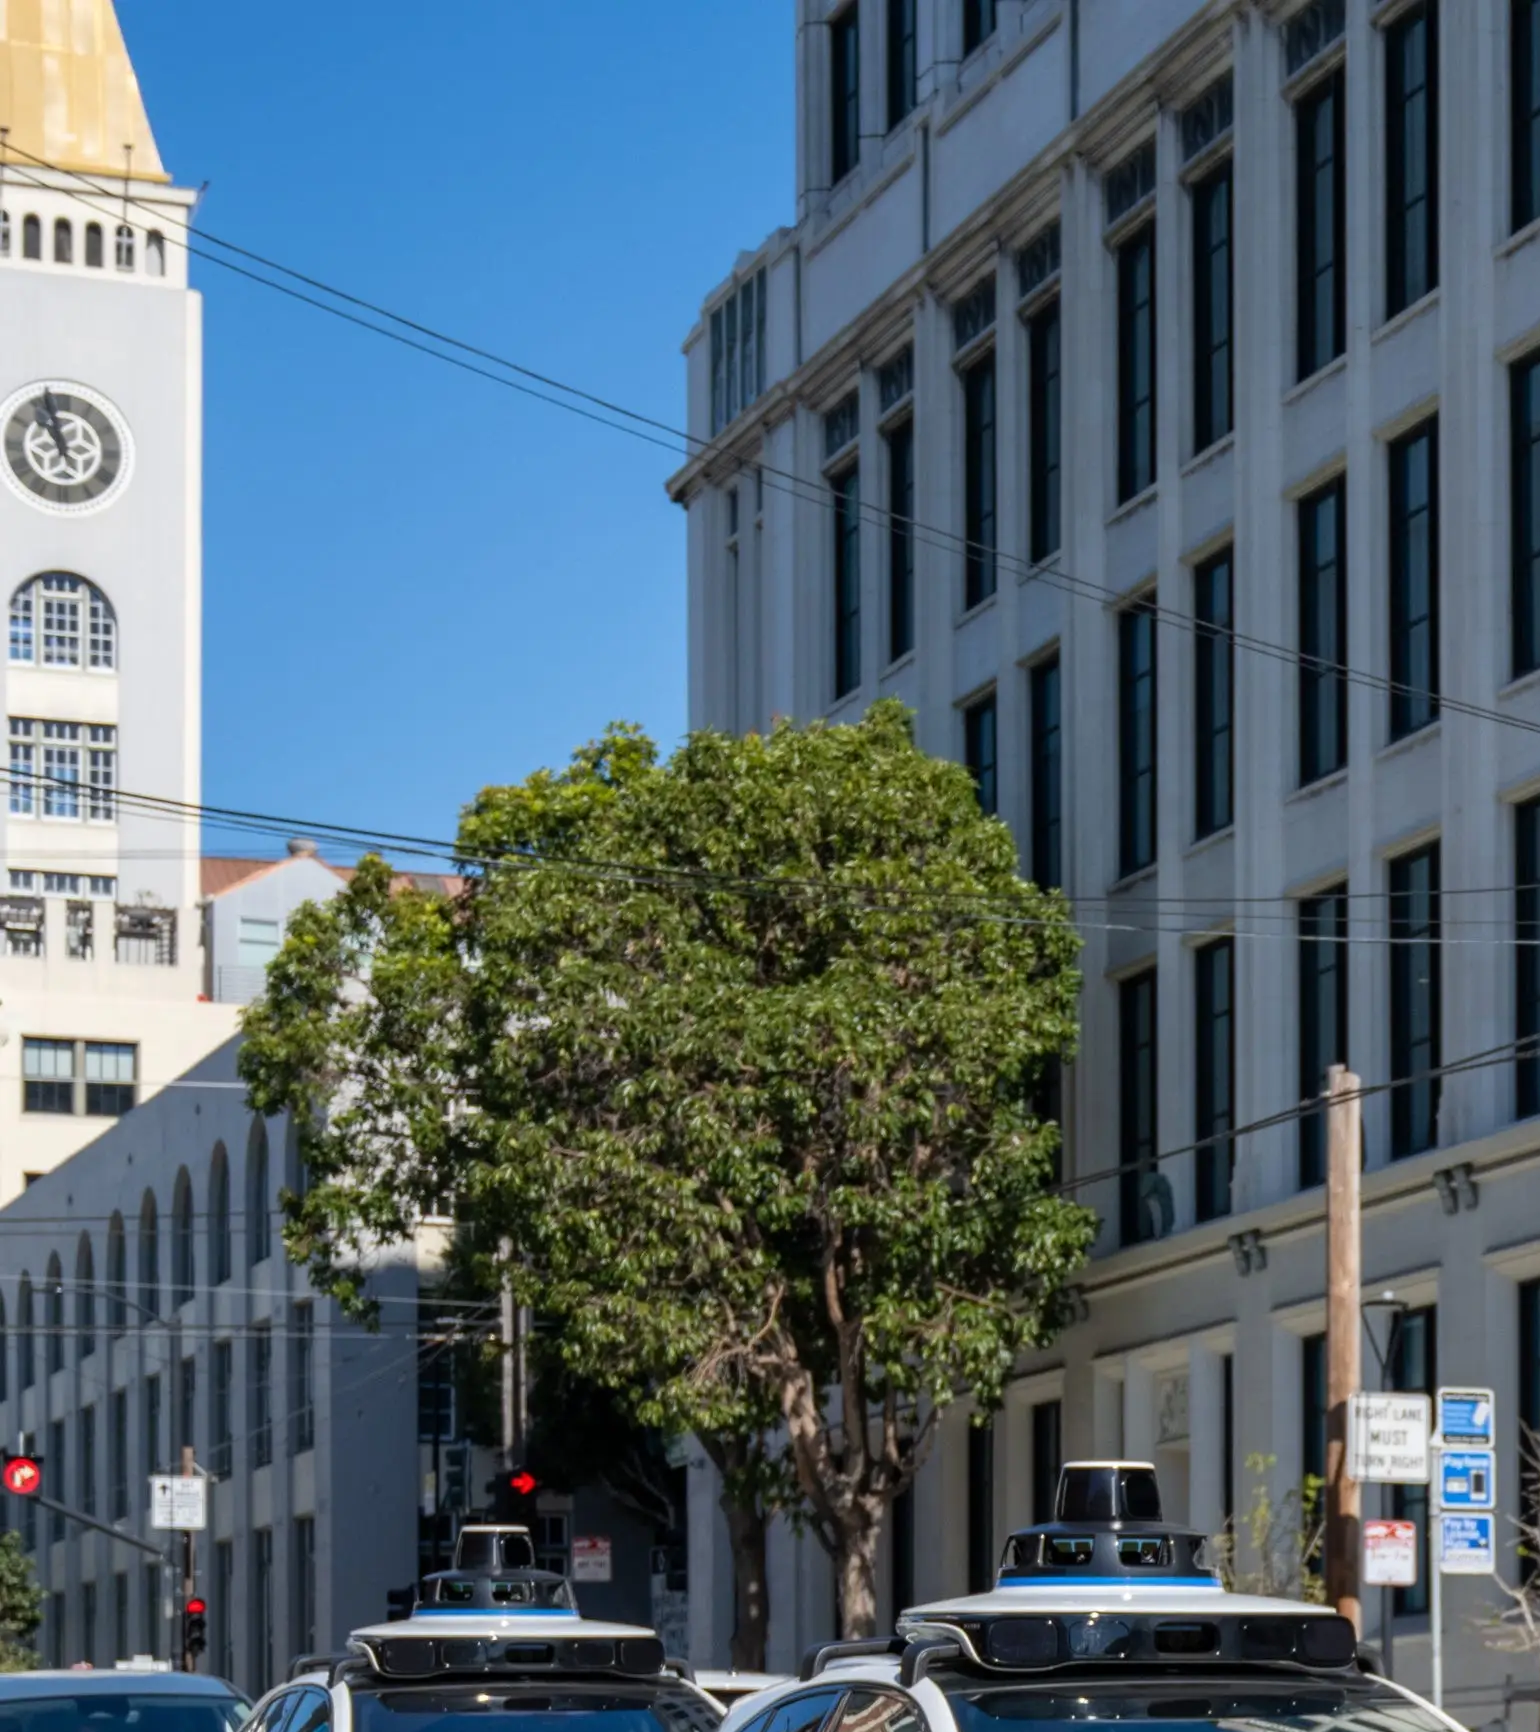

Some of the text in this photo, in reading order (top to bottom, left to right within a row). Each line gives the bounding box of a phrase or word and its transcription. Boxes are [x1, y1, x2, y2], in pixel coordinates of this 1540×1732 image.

[1355, 1406, 1422, 1422] RIGHT LANE
[1370, 1430, 1408, 1446] MUST
[1355, 1453, 1424, 1469] TURN RIGHT
